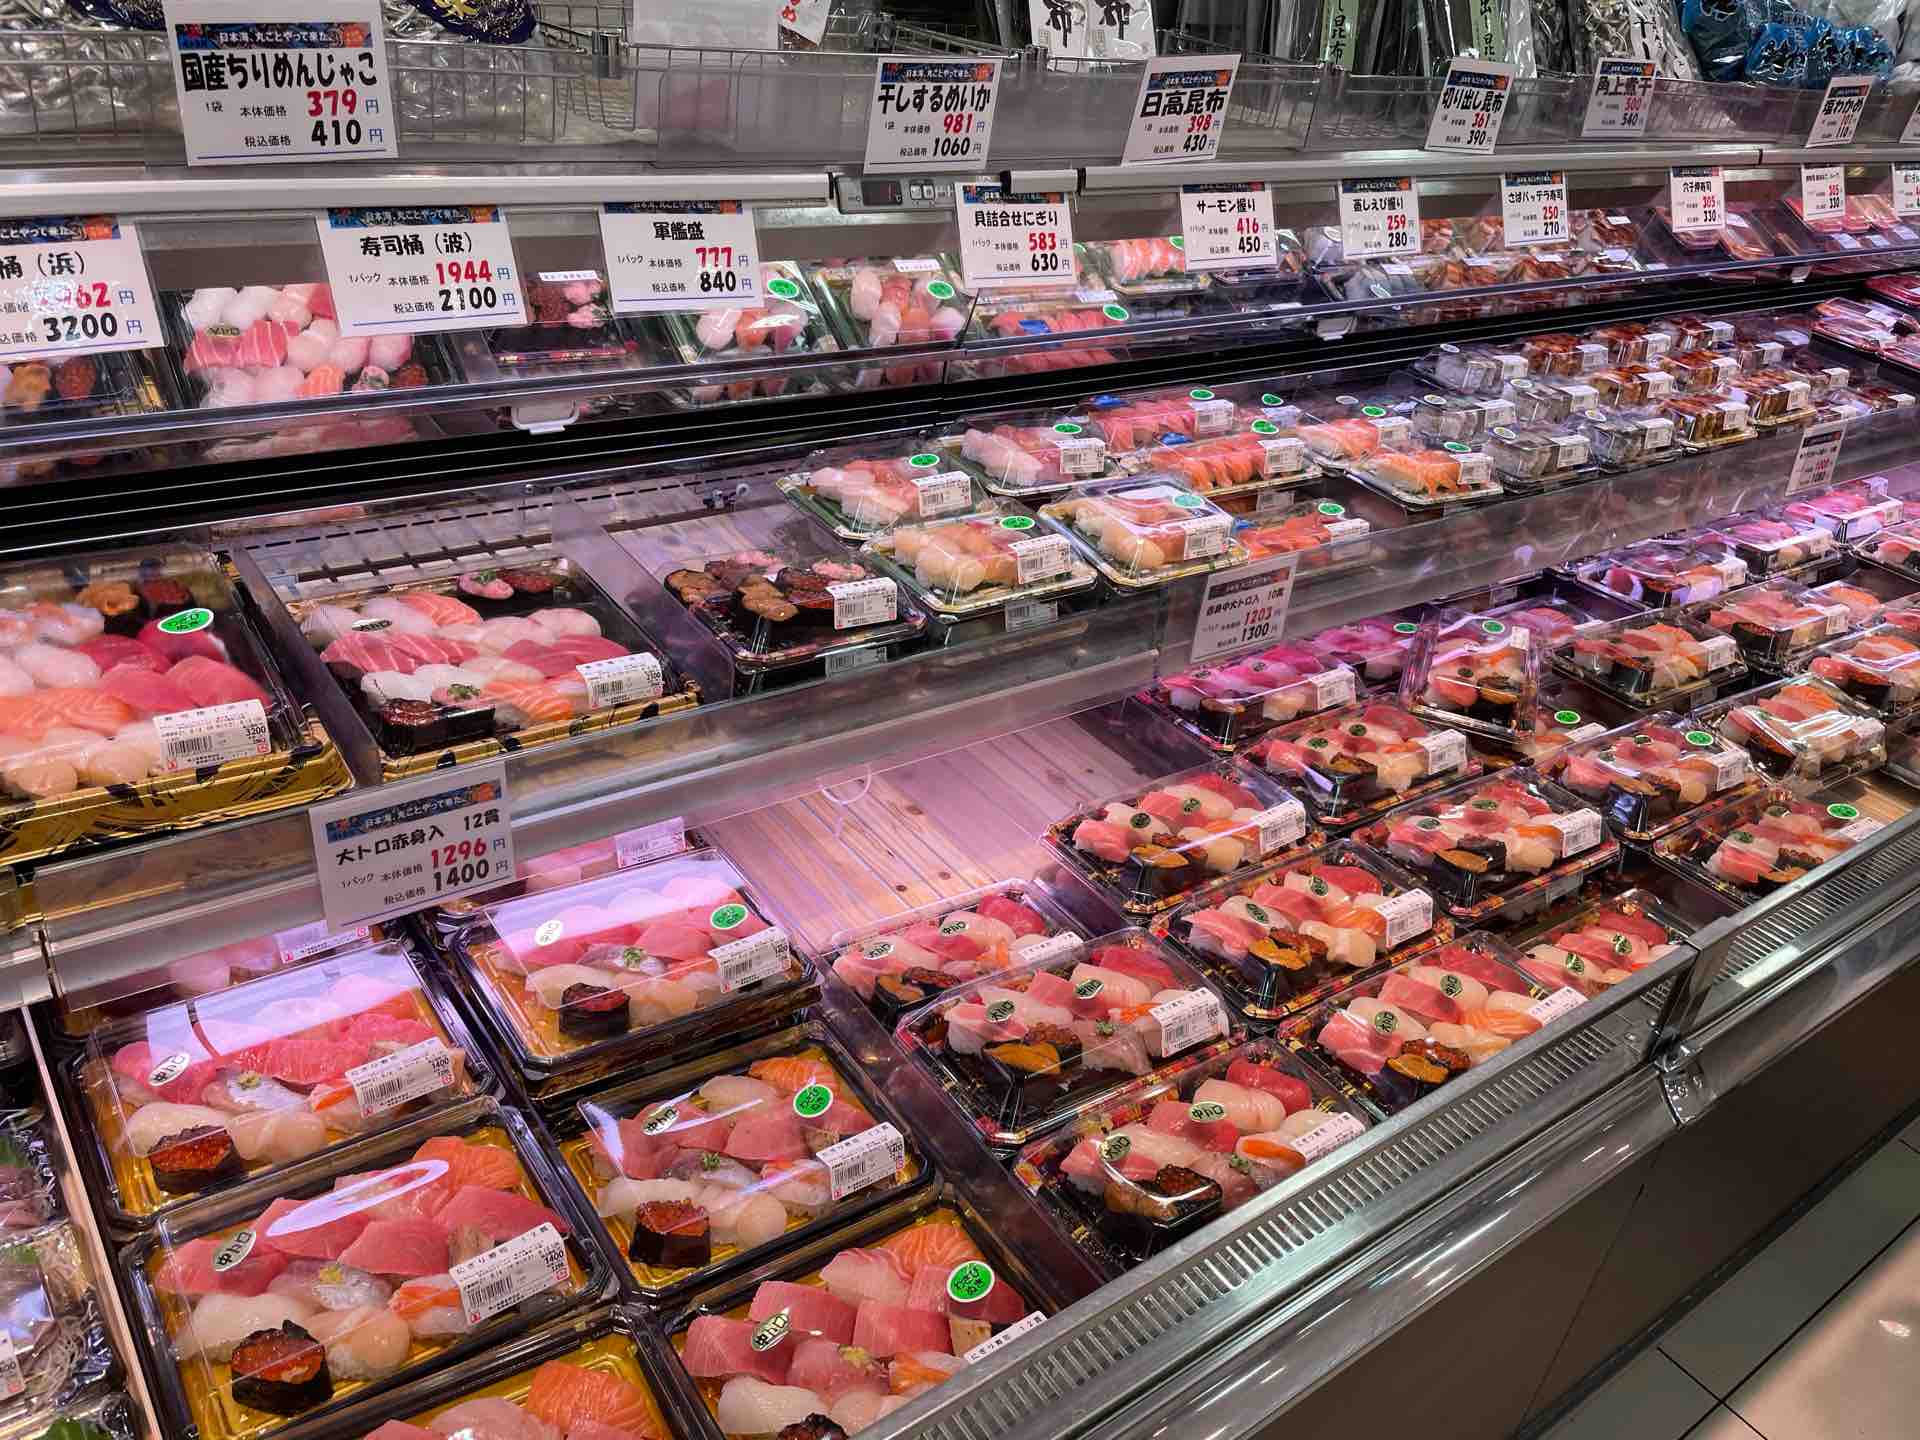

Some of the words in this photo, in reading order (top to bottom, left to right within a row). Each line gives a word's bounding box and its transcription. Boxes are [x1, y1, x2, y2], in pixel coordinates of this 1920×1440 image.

[180, 52, 378, 92] 国産ちりめんじゃこ
[240, 105, 287, 117] 本体価格
[306, 89, 358, 118] 379
[365, 99, 379, 114] 円
[878, 84, 991, 114] 干しするめいか
[1140, 89, 1227, 117] 日高昆布
[1442, 87, 1504, 113] 切り出し昆布
[943, 113, 972, 133] 981
[1187, 114, 1212, 133] 398
[1472, 112, 1491, 128] 361
[244, 135, 292, 147] 税込価格
[311, 120, 361, 146] 410
[368, 128, 384, 143] 円
[1183, 134, 1207, 152] 430
[1467, 130, 1486, 145] 390
[932, 137, 970, 156] 1060
[1196, 198, 1256, 214] サーモン握り
[1543, 206, 1558, 220] 250
[975, 210, 1058, 227] 貝詰合せにぎり
[1237, 217, 1259, 235] 416
[1387, 214, 1406, 231] 259
[653, 221, 705, 240] 軍艦盛
[1543, 222, 1560, 235] 270
[1029, 232, 1056, 251] 583
[1238, 236, 1260, 253] 450
[1388, 232, 1407, 248] 280
[695, 246, 732, 268] 777
[739, 255, 749, 266] 円
[1031, 253, 1058, 271] 630
[388, 275, 430, 286] 本体価格
[435, 260, 492, 285] 1944
[497, 267, 510, 280] 円
[700, 271, 737, 292] 840
[741, 279, 752, 290] 円
[119, 290, 135, 304] 円
[393, 302, 435, 313] 税込価格
[439, 287, 496, 311] 2100
[504, 293, 517, 305] 円
[43, 313, 118, 342] 3200
[127, 320, 143, 335] 円
[1244, 606, 1272, 625] 1203
[1241, 622, 1270, 641] 1300
[336, 824, 444, 866] 大トロ赤身入
[464, 808, 500, 831] 12貫
[381, 863, 423, 881] 本体価格
[431, 837, 487, 869] 1296
[493, 838, 505, 851] 円
[433, 858, 490, 892] 1400
[495, 860, 508, 874] 円
[545, 1250, 564, 1264] 1400
